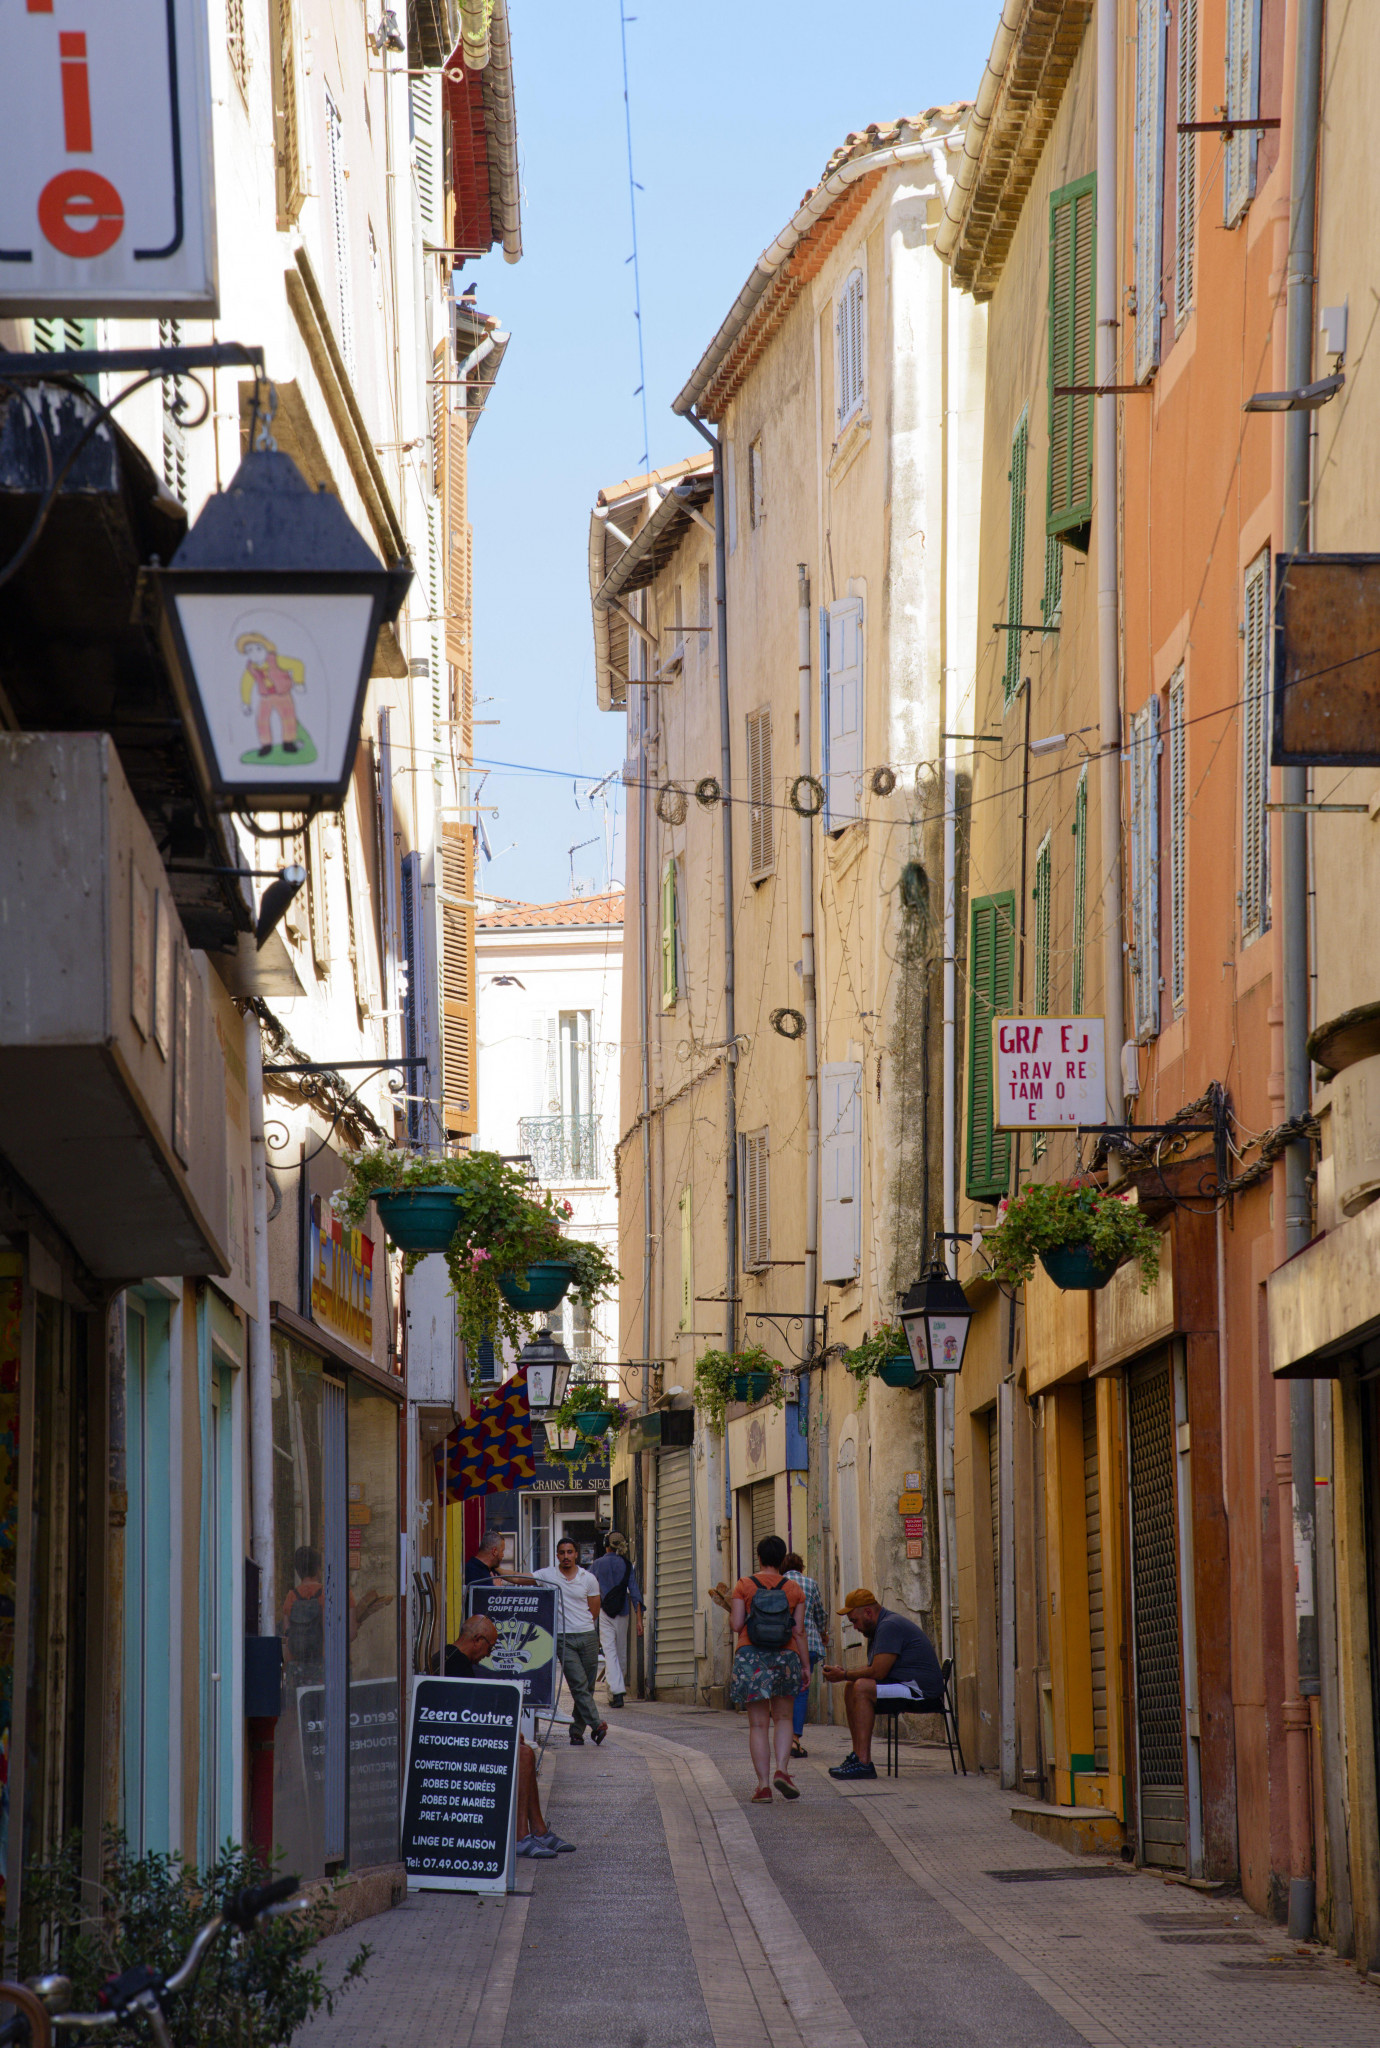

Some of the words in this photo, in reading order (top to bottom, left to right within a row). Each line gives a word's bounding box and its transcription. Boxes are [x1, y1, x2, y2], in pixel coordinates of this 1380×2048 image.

[588, 1478, 611, 1490] SIEC
[487, 1595, 540, 1606] COIFFEUR
[487, 1605, 513, 1613] COUPE
[513, 1605, 539, 1613] BARBE
[419, 1707, 458, 1722] Zeera
[460, 1709, 514, 1726] Couture
[418, 1734, 470, 1748] RETOUCHES
[471, 1737, 509, 1750] EXPRESS
[414, 1759, 462, 1772] CONFECTION
[463, 1762, 478, 1773] SUR
[478, 1763, 508, 1775] MESURE
[420, 1778, 449, 1789] .ROBES
[450, 1779, 462, 1790] DE
[462, 1779, 496, 1792] SOIRÉES
[419, 1794, 448, 1806] .ROBES
[448, 1795, 460, 1806] DE
[461, 1796, 496, 1809] MARIÉES
[412, 1835, 440, 1847] LINGE
[441, 1836, 455, 1848] DE
[456, 1838, 496, 1850] MAISON
[405, 1856, 421, 1868] Tel:
[422, 1857, 499, 1872] 07.49.00.39.32
